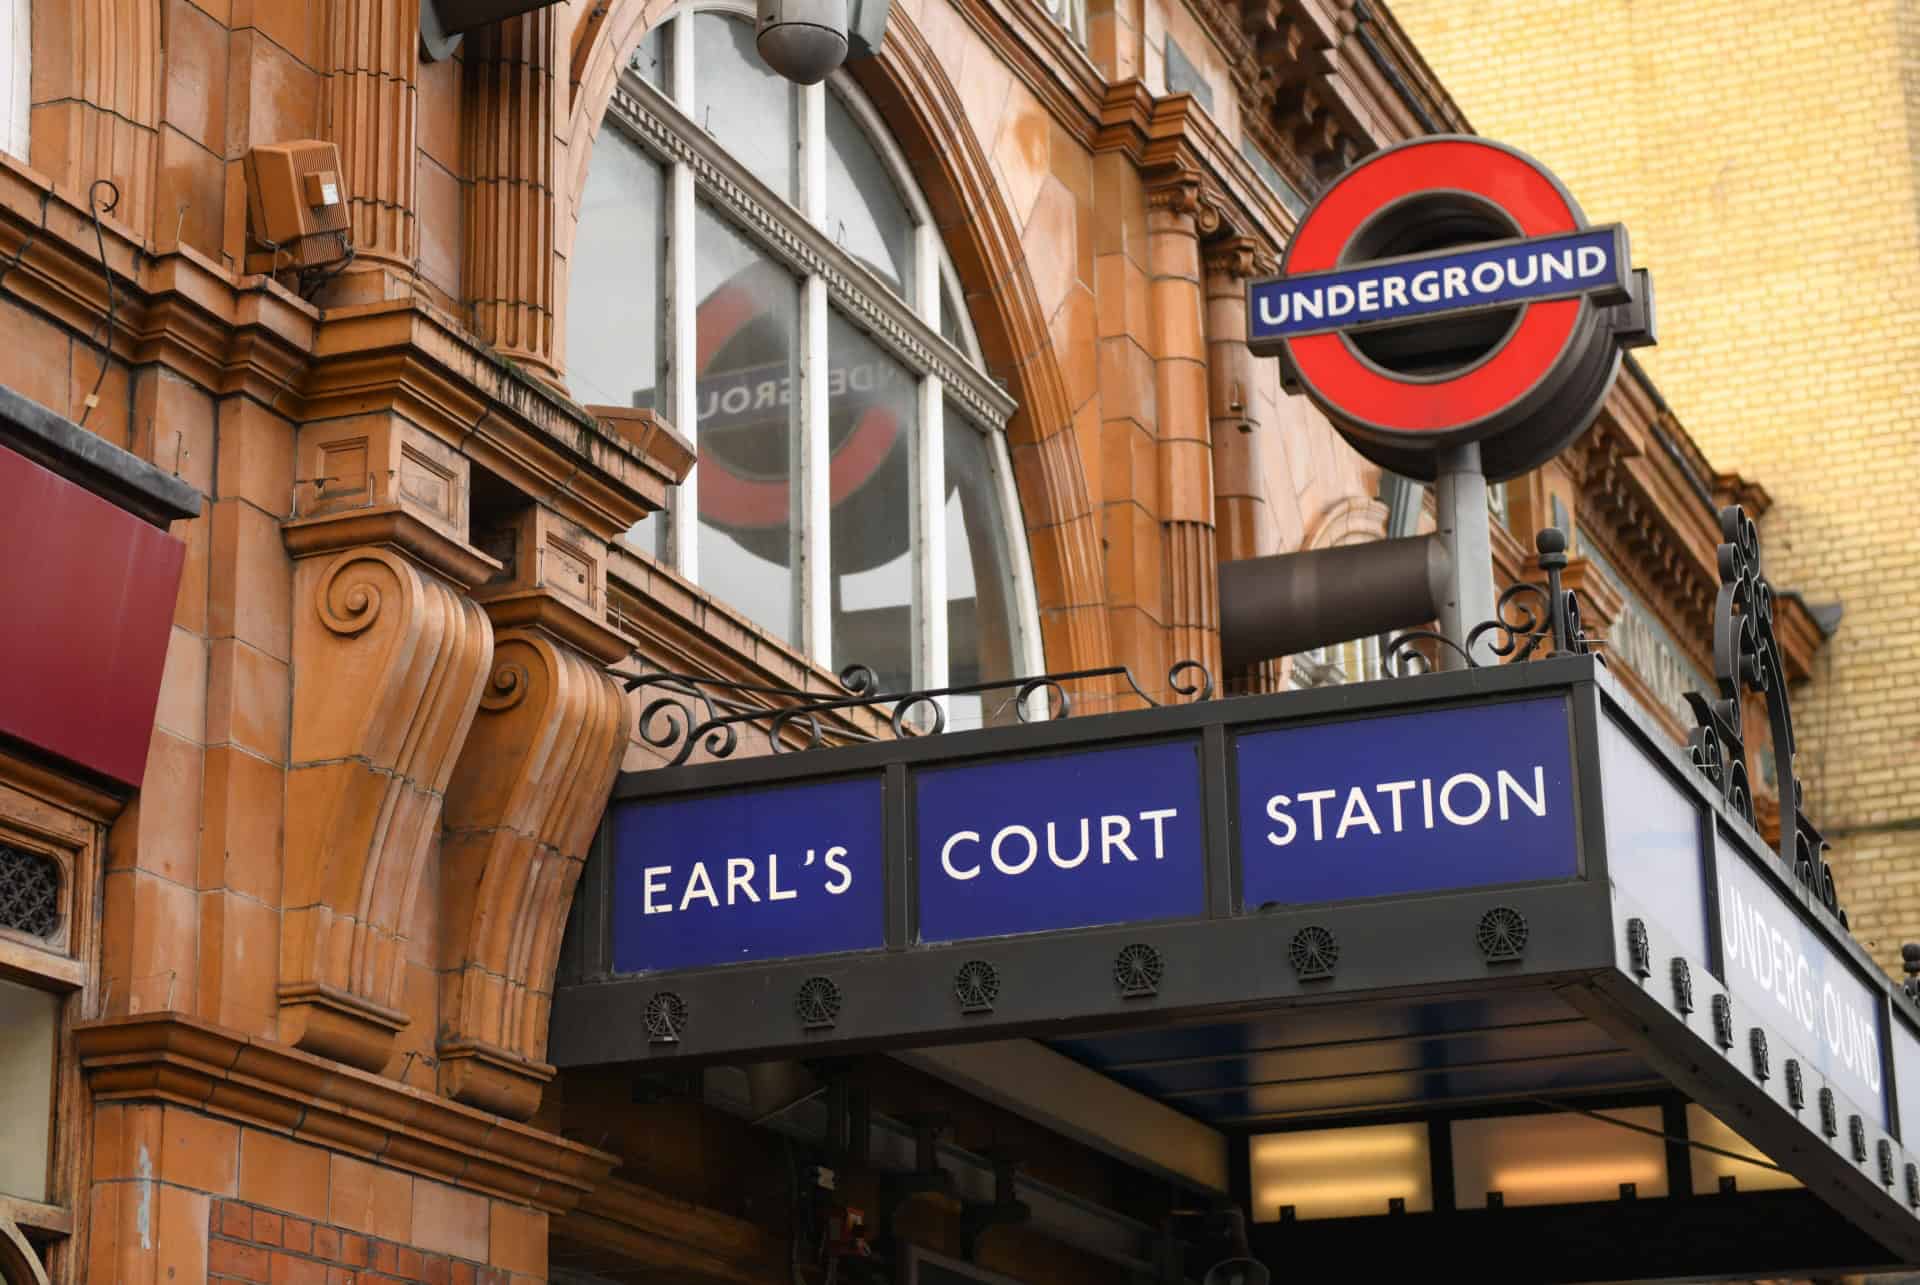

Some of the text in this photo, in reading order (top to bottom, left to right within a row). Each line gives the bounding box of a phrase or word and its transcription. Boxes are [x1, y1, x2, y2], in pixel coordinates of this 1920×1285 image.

[1259, 245, 1607, 326] UNDERGROUND
[643, 766, 1547, 914] EARL'S COURT STATION
